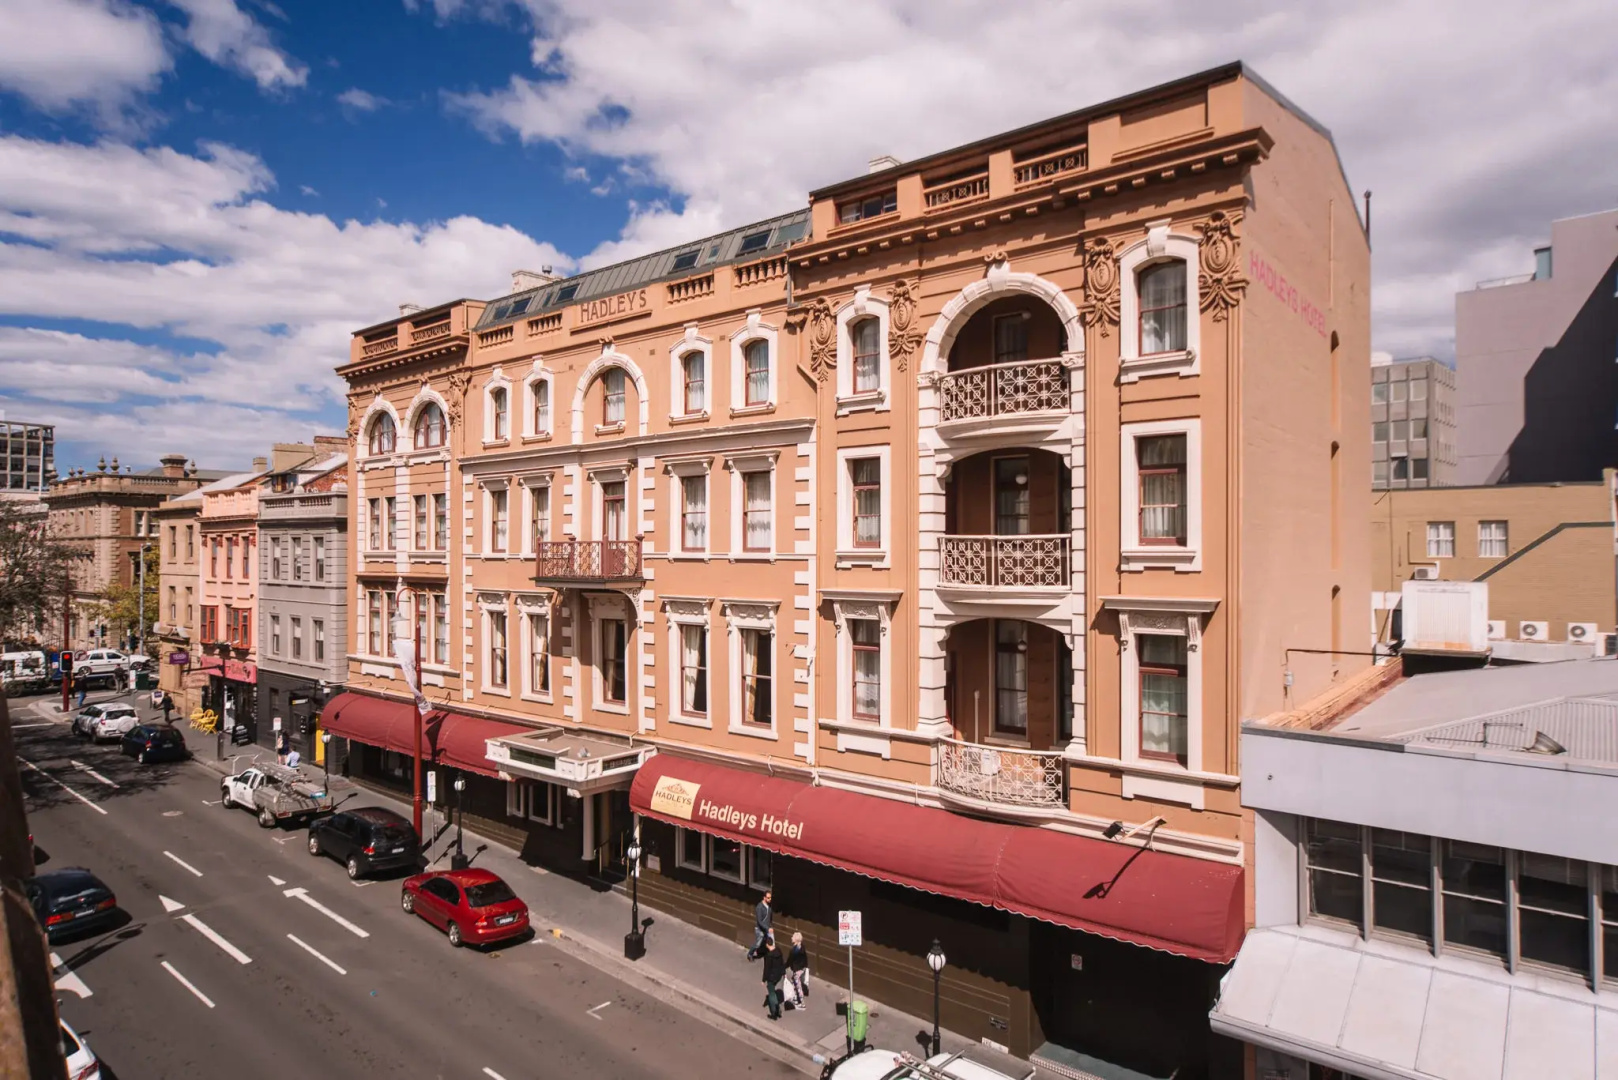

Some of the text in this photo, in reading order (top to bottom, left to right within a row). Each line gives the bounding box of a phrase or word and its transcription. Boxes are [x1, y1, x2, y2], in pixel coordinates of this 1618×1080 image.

[580, 290, 646, 323] HADLEYS
[1250, 249, 1327, 338] HADLEYS HOTEL
[655, 790, 692, 806] HADLEYS
[698, 799, 804, 840] Hadleys Hotel
